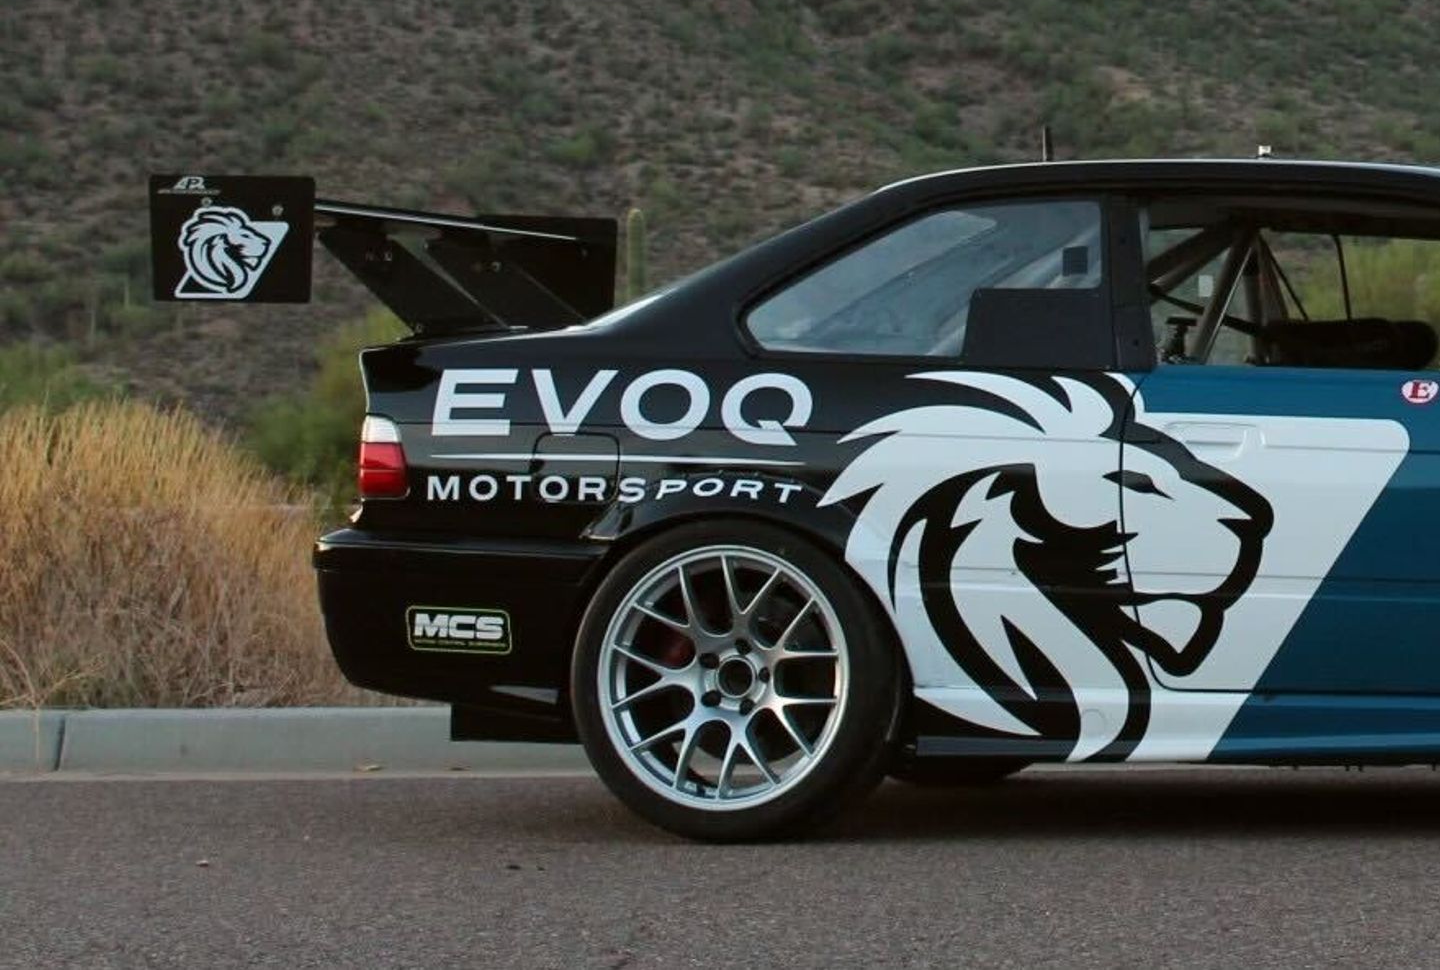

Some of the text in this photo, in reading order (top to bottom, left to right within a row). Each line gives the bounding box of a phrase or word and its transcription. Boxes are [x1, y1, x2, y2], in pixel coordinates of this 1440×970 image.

[1408, 381, 1432, 399] E
[431, 368, 813, 446] EVOQ
[427, 474, 802, 504] MOTORSPORT
[414, 613, 504, 640] MCS
